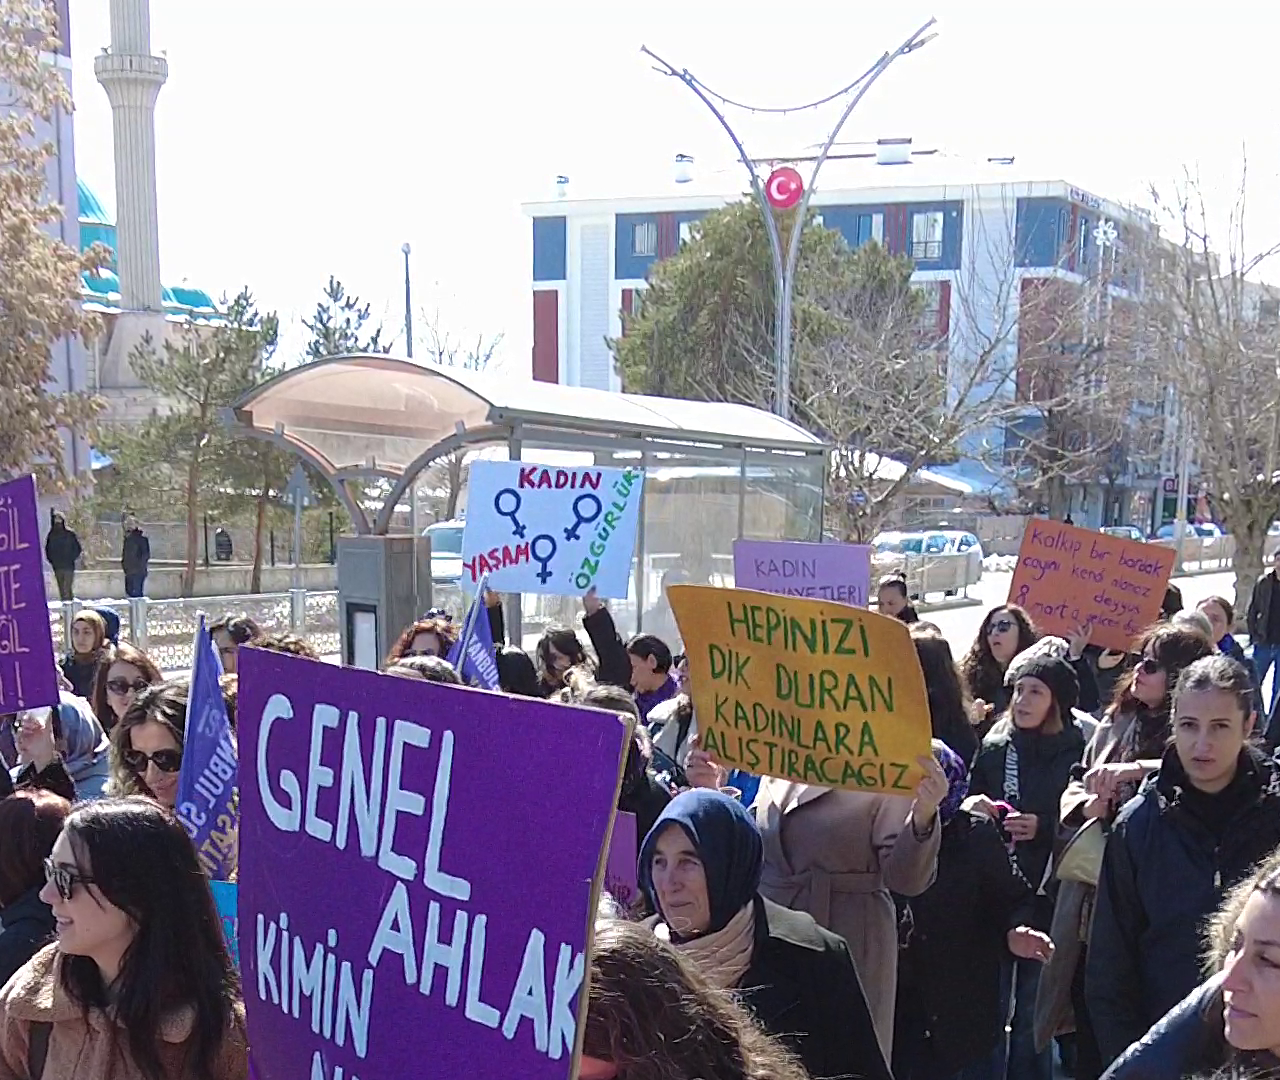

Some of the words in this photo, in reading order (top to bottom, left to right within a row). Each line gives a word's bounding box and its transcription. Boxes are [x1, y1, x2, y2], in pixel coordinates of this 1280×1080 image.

[518, 466, 602, 490] KADIN
[569, 468, 640, 589] ÖZGÜRLÜK
[462, 541, 531, 583] YAŞAM
[754, 558, 818, 579] KADIN
[1119, 548, 1164, 577] bardak
[727, 600, 870, 659] HEPİNİZİ
[708, 643, 752, 691] DİK
[776, 662, 895, 713] DURAN
[714, 693, 879, 757] KADINLARA
[256, 692, 472, 901] GENEL
[255, 911, 374, 1060] KİMİN
[367, 880, 585, 1060] AHLAK
